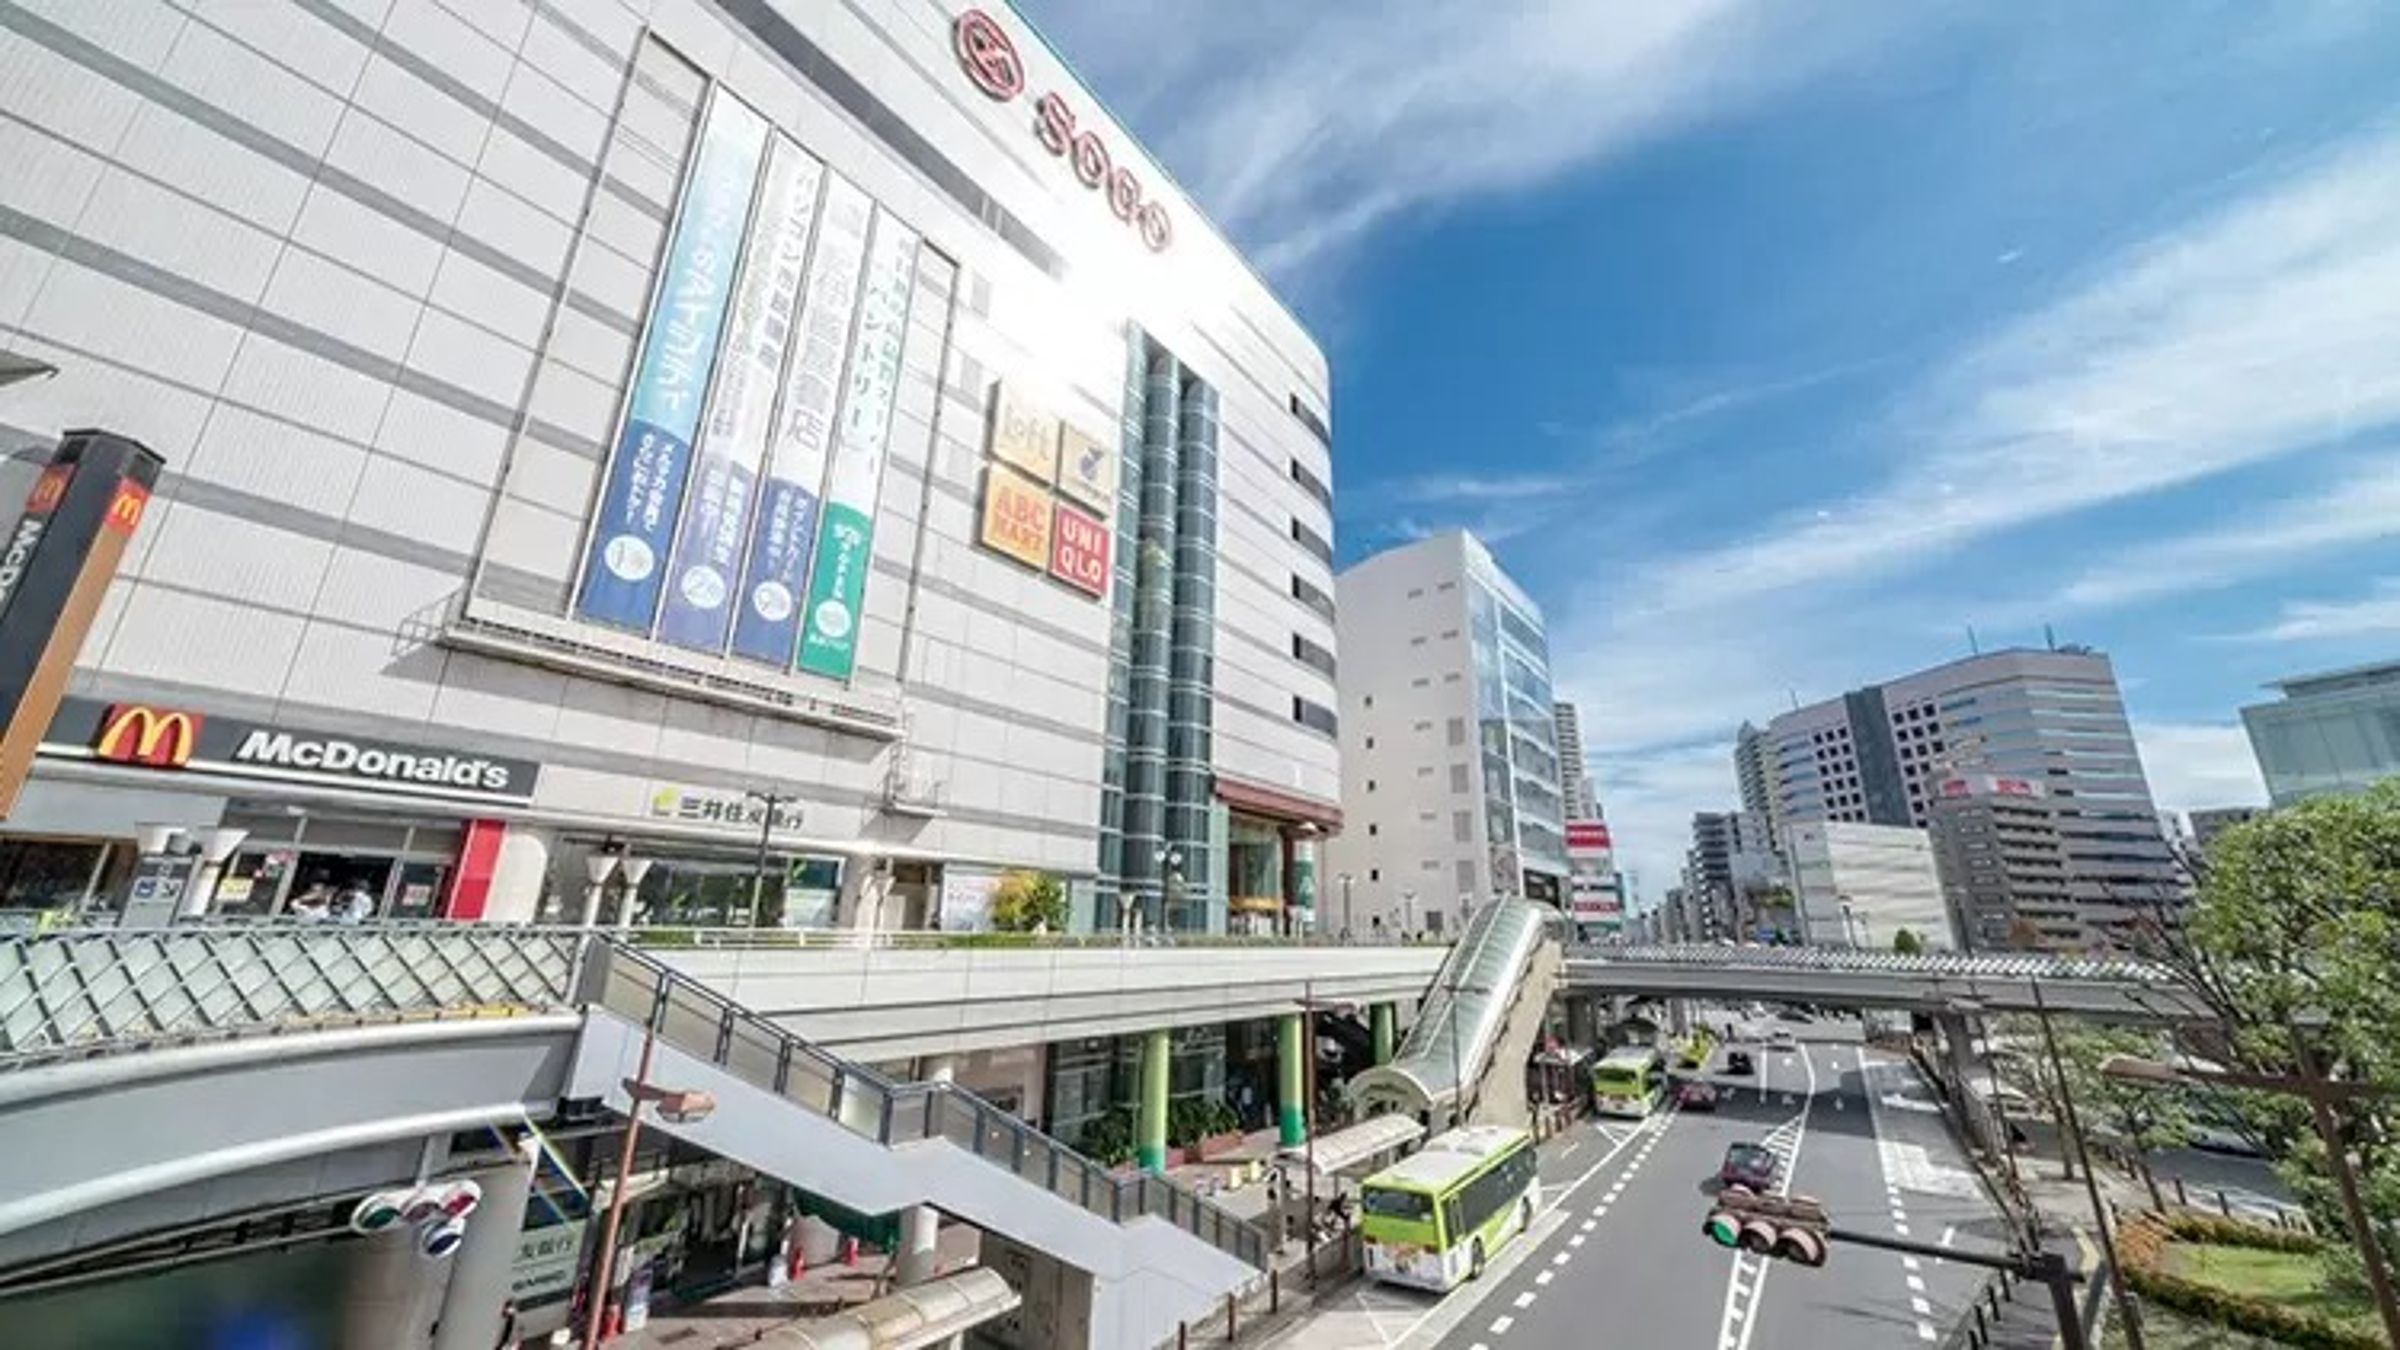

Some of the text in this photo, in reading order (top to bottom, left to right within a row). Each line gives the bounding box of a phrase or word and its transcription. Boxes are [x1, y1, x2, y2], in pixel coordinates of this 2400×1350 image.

[1034, 92, 1172, 252] SOGO
[997, 485, 1046, 532] ABC
[997, 514, 1044, 552] MART
[1062, 513, 1102, 553] UNI
[1061, 545, 1102, 583] QLO
[237, 730, 509, 788] McDonald's
